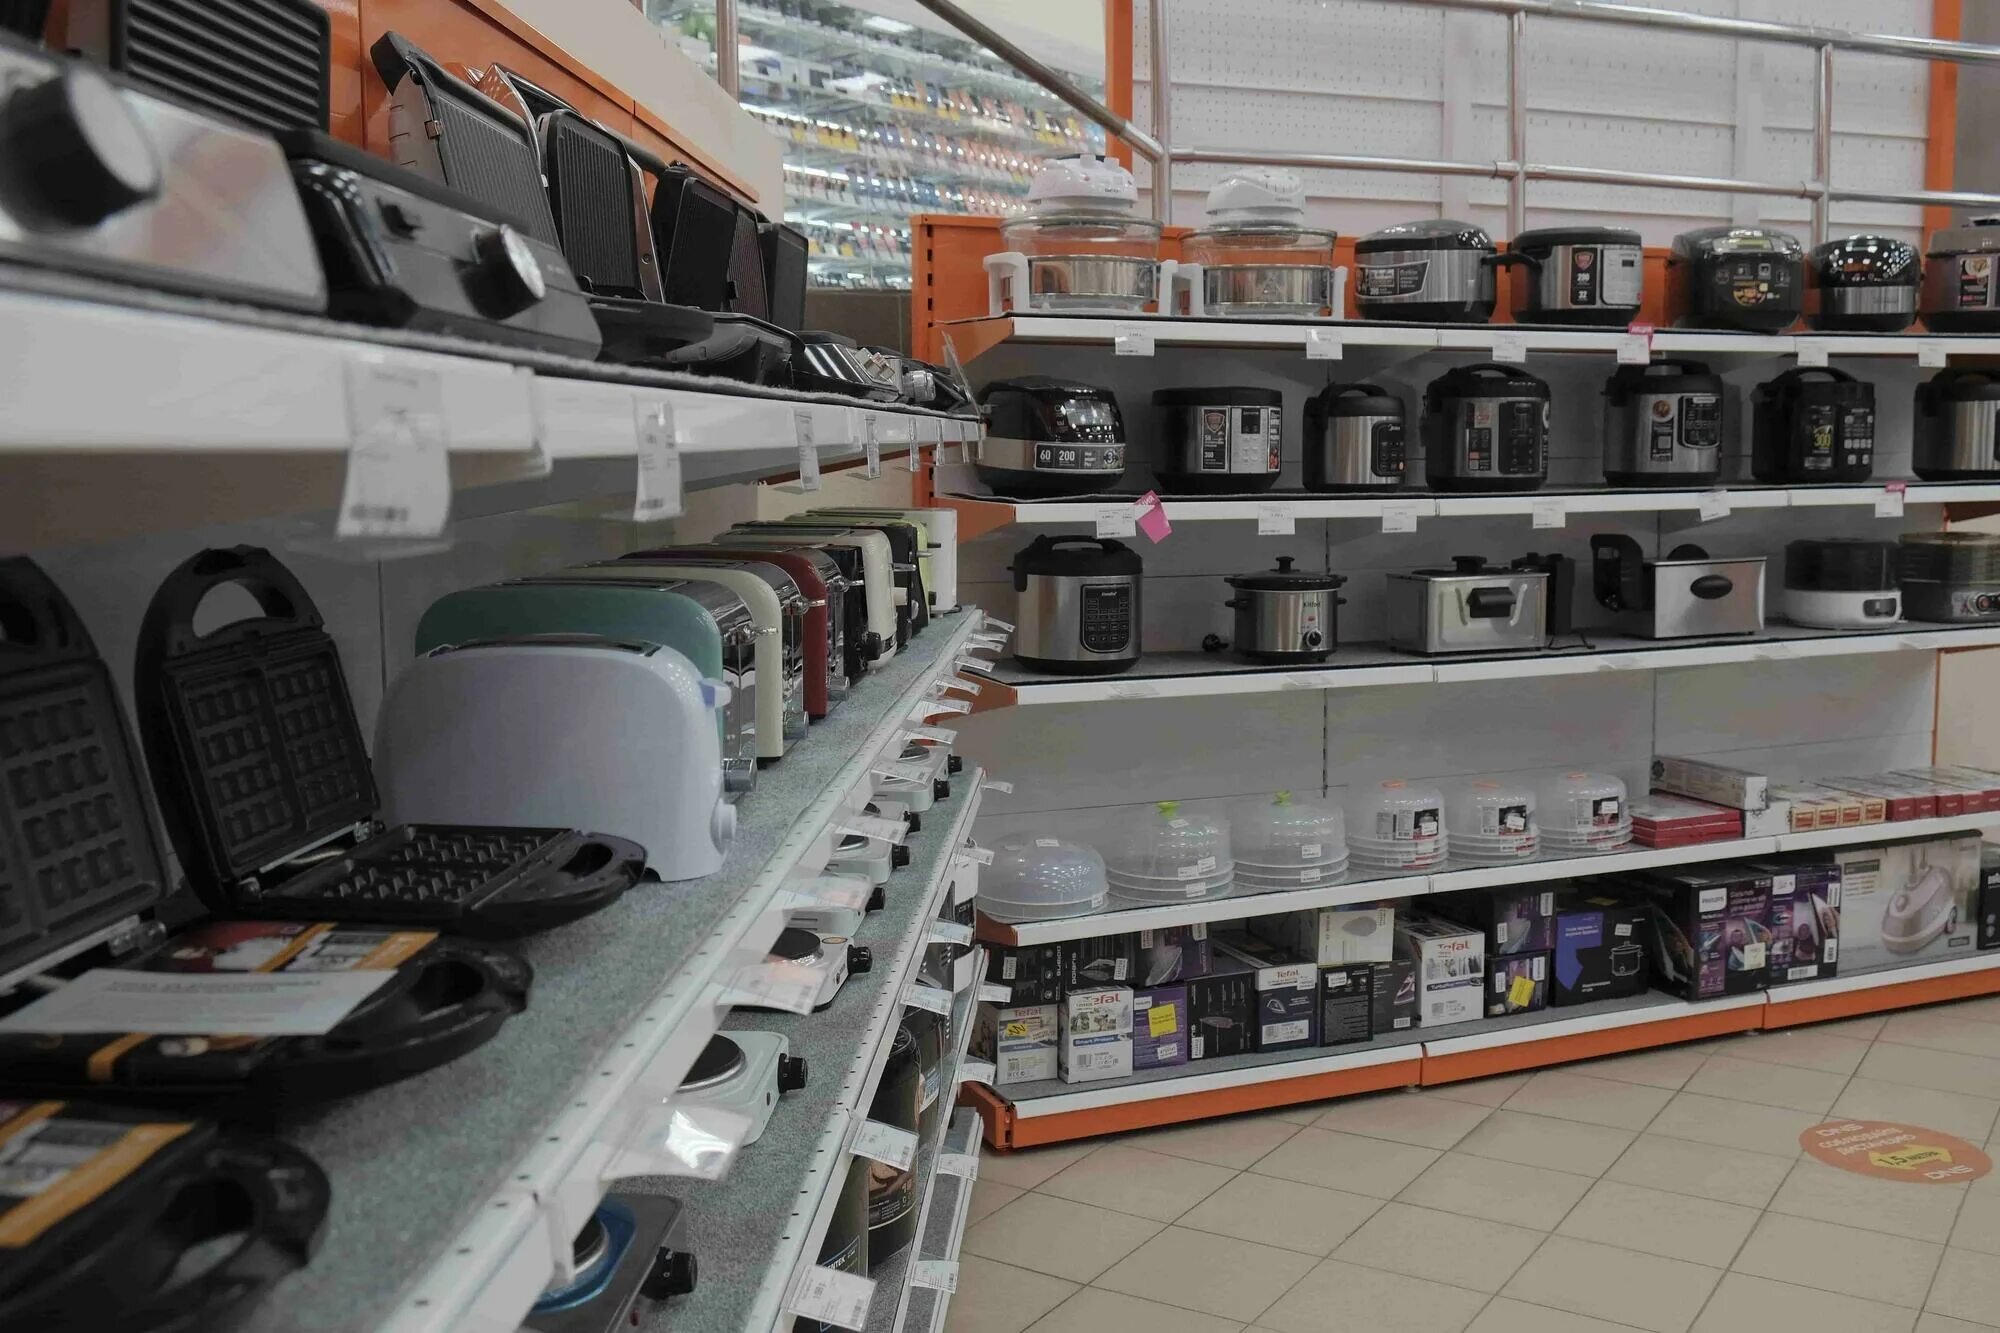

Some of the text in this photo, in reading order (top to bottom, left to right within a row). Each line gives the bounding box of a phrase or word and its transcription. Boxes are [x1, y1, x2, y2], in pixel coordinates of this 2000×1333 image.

[1814, 433, 1832, 449] 300
[1040, 449, 1051, 460] 60
[1058, 450, 1076, 461] 200
[1436, 940, 1471, 951] Tefal
[1277, 969, 1300, 978] Tefal
[1014, 1007, 1042, 1017] Tefal
[1923, 1164, 1975, 1180] DNS
